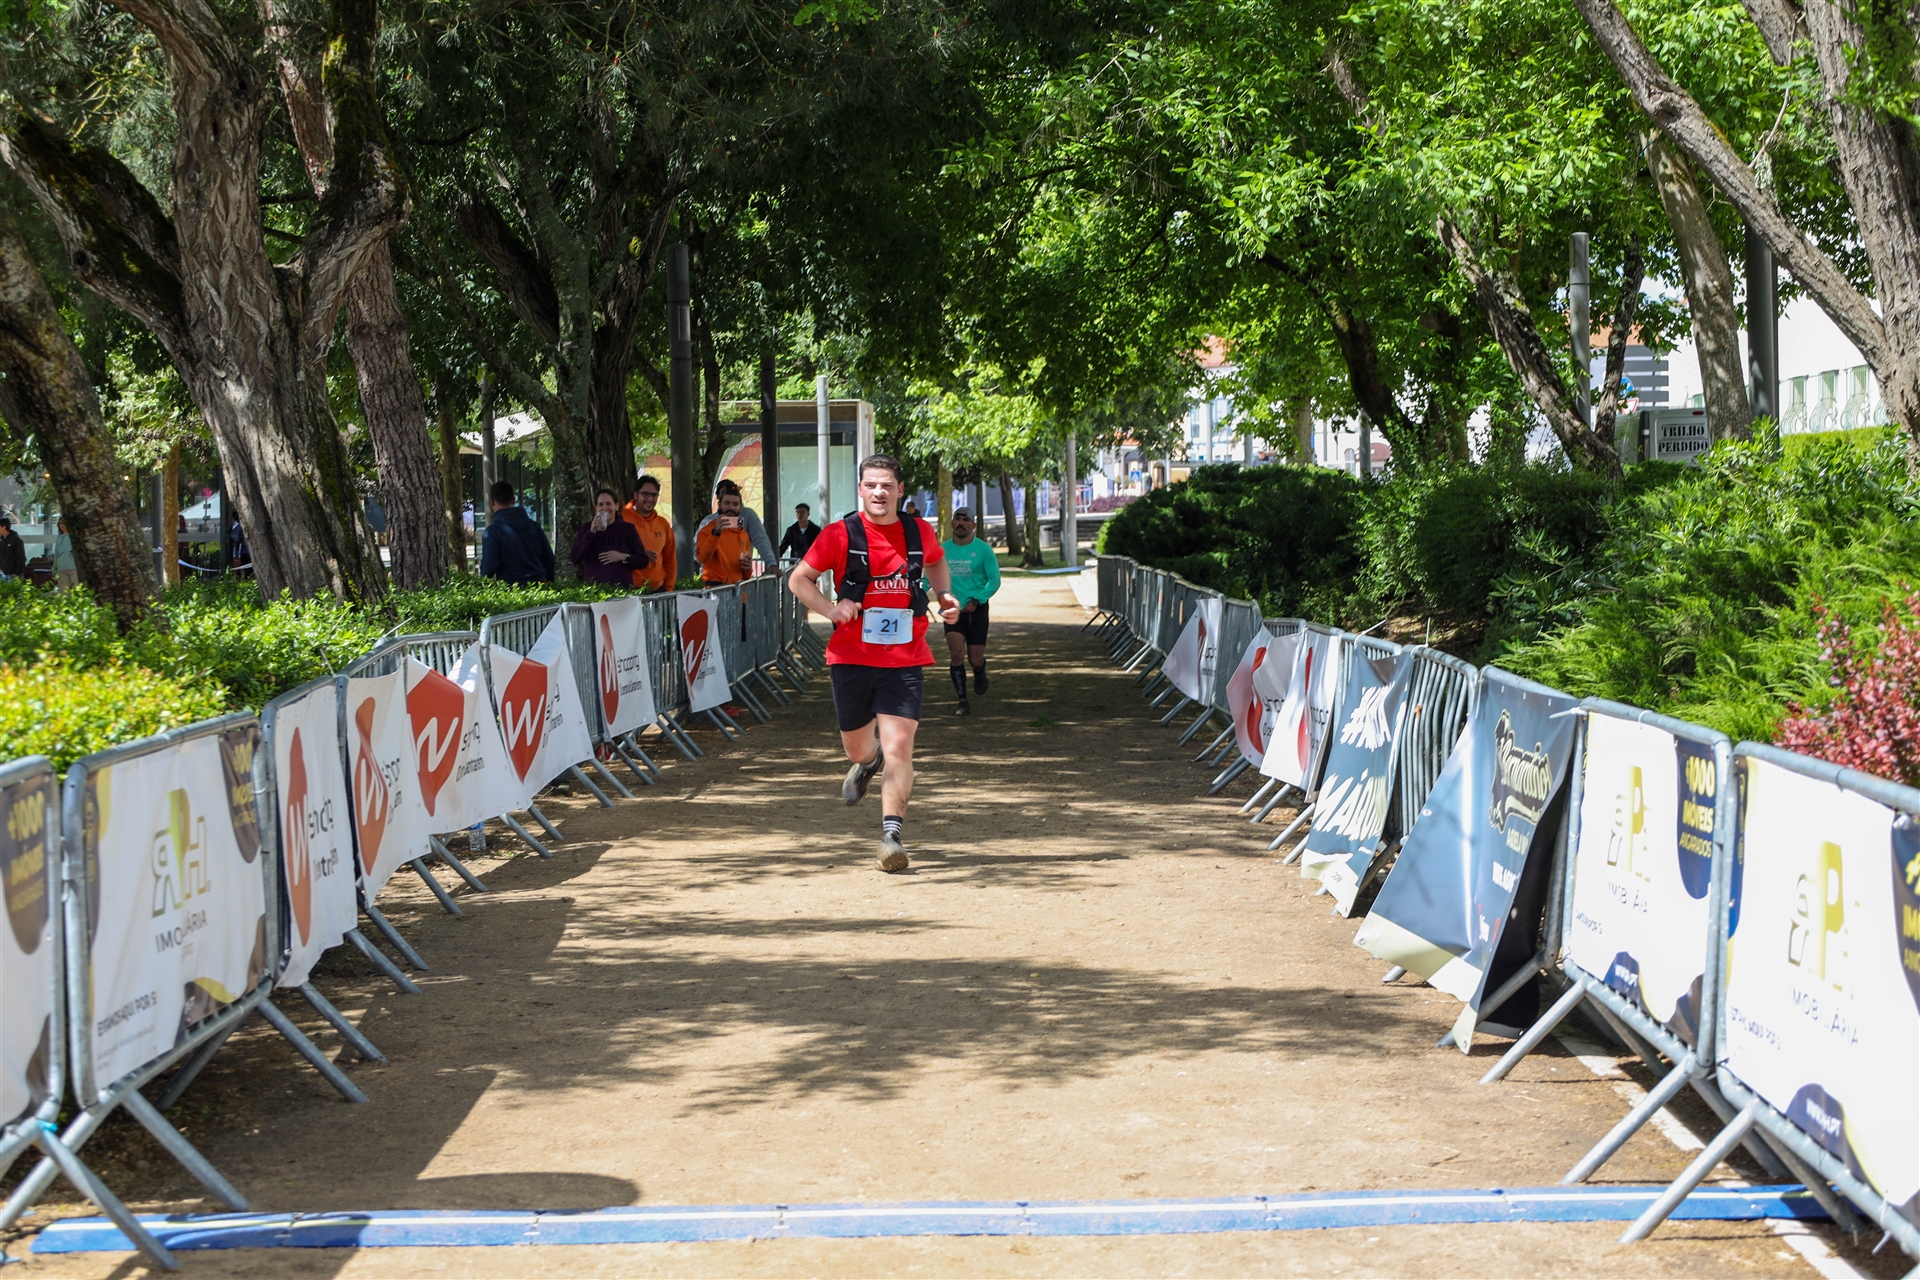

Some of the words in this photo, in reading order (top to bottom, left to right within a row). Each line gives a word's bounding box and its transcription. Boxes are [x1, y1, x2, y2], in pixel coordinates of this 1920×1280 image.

[1661, 425, 1705, 437] TRILHO
[1658, 440, 1708, 452] PERDIDO
[880, 618, 899, 633] 21
[1685, 755, 1716, 798] +1000
